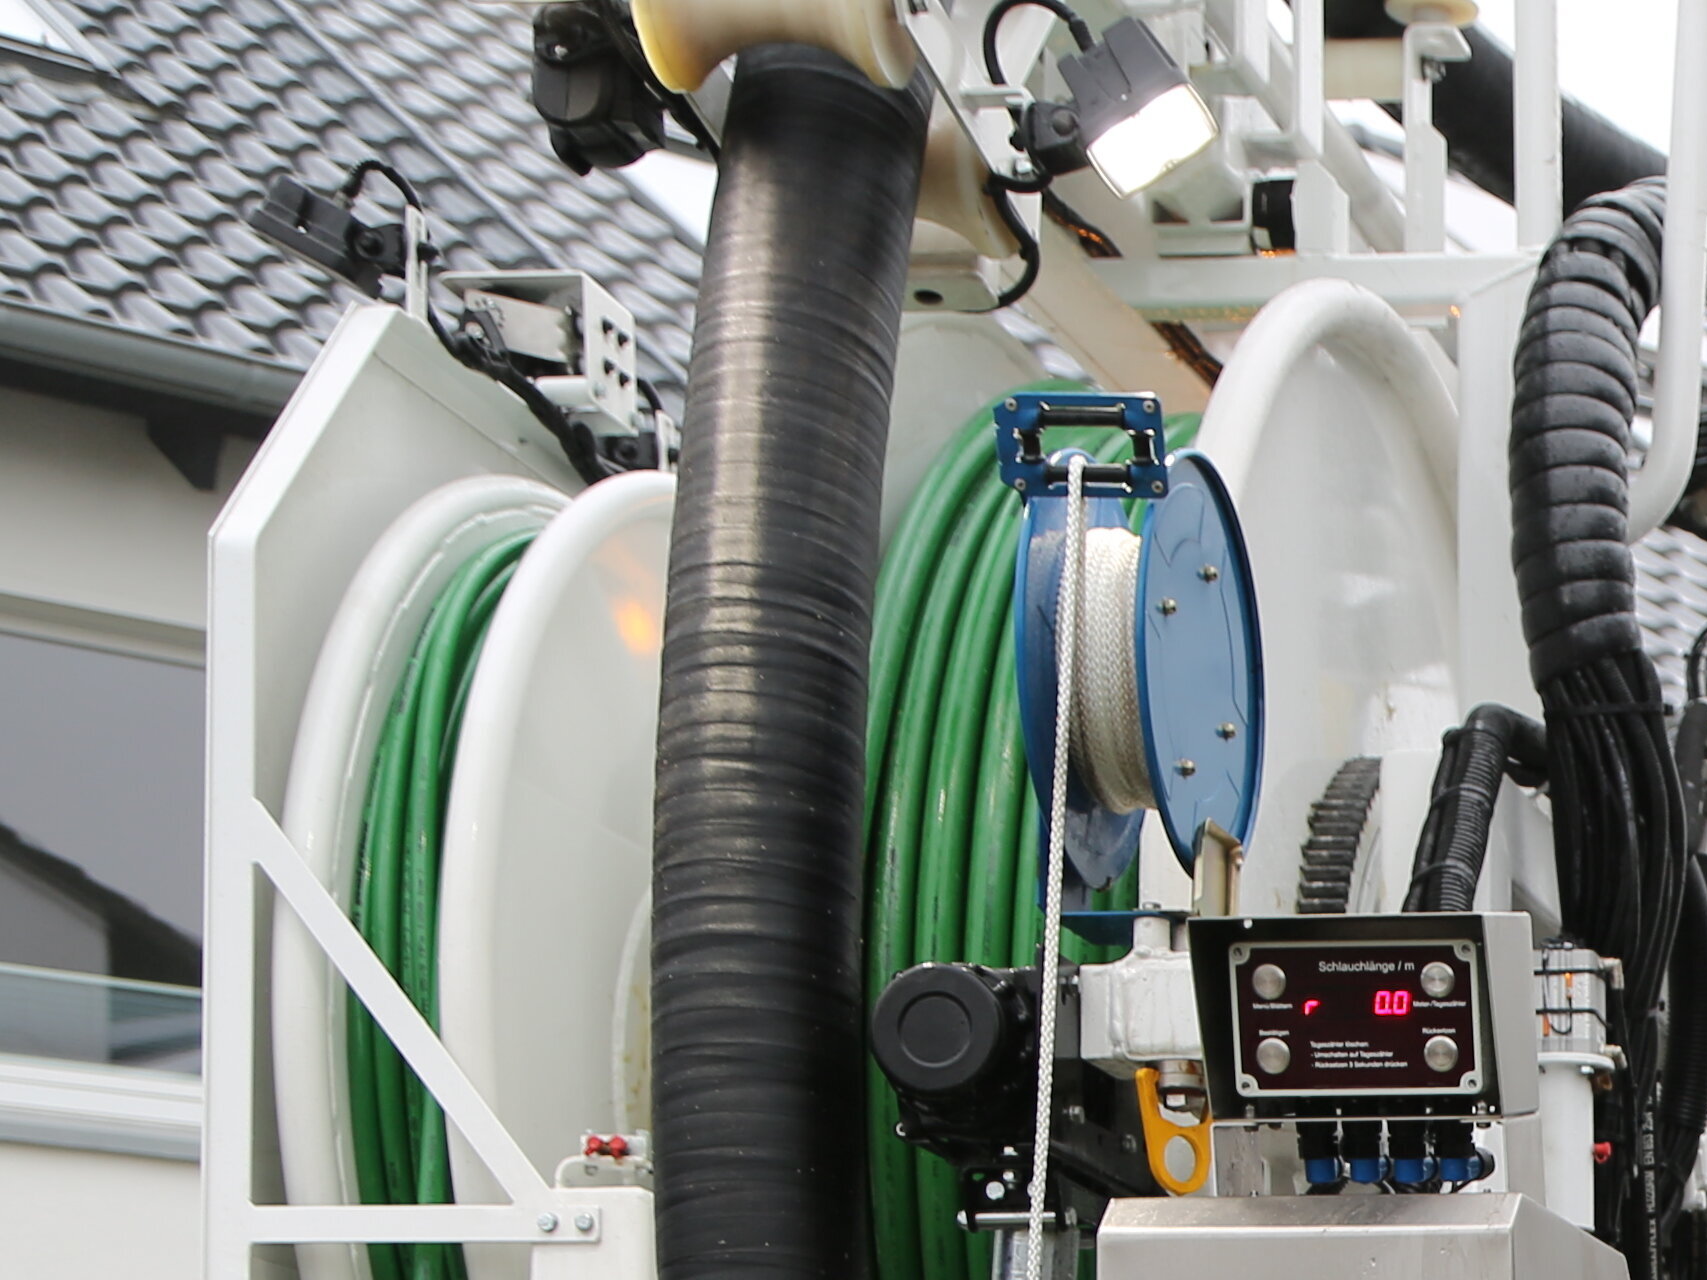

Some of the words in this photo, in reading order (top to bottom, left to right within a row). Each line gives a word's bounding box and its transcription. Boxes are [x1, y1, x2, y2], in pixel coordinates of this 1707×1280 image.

[1318, 960, 1395, 974] Schlauchlänge
[1404, 962, 1415, 971] m
[1374, 990, 1409, 1015] 0.0
